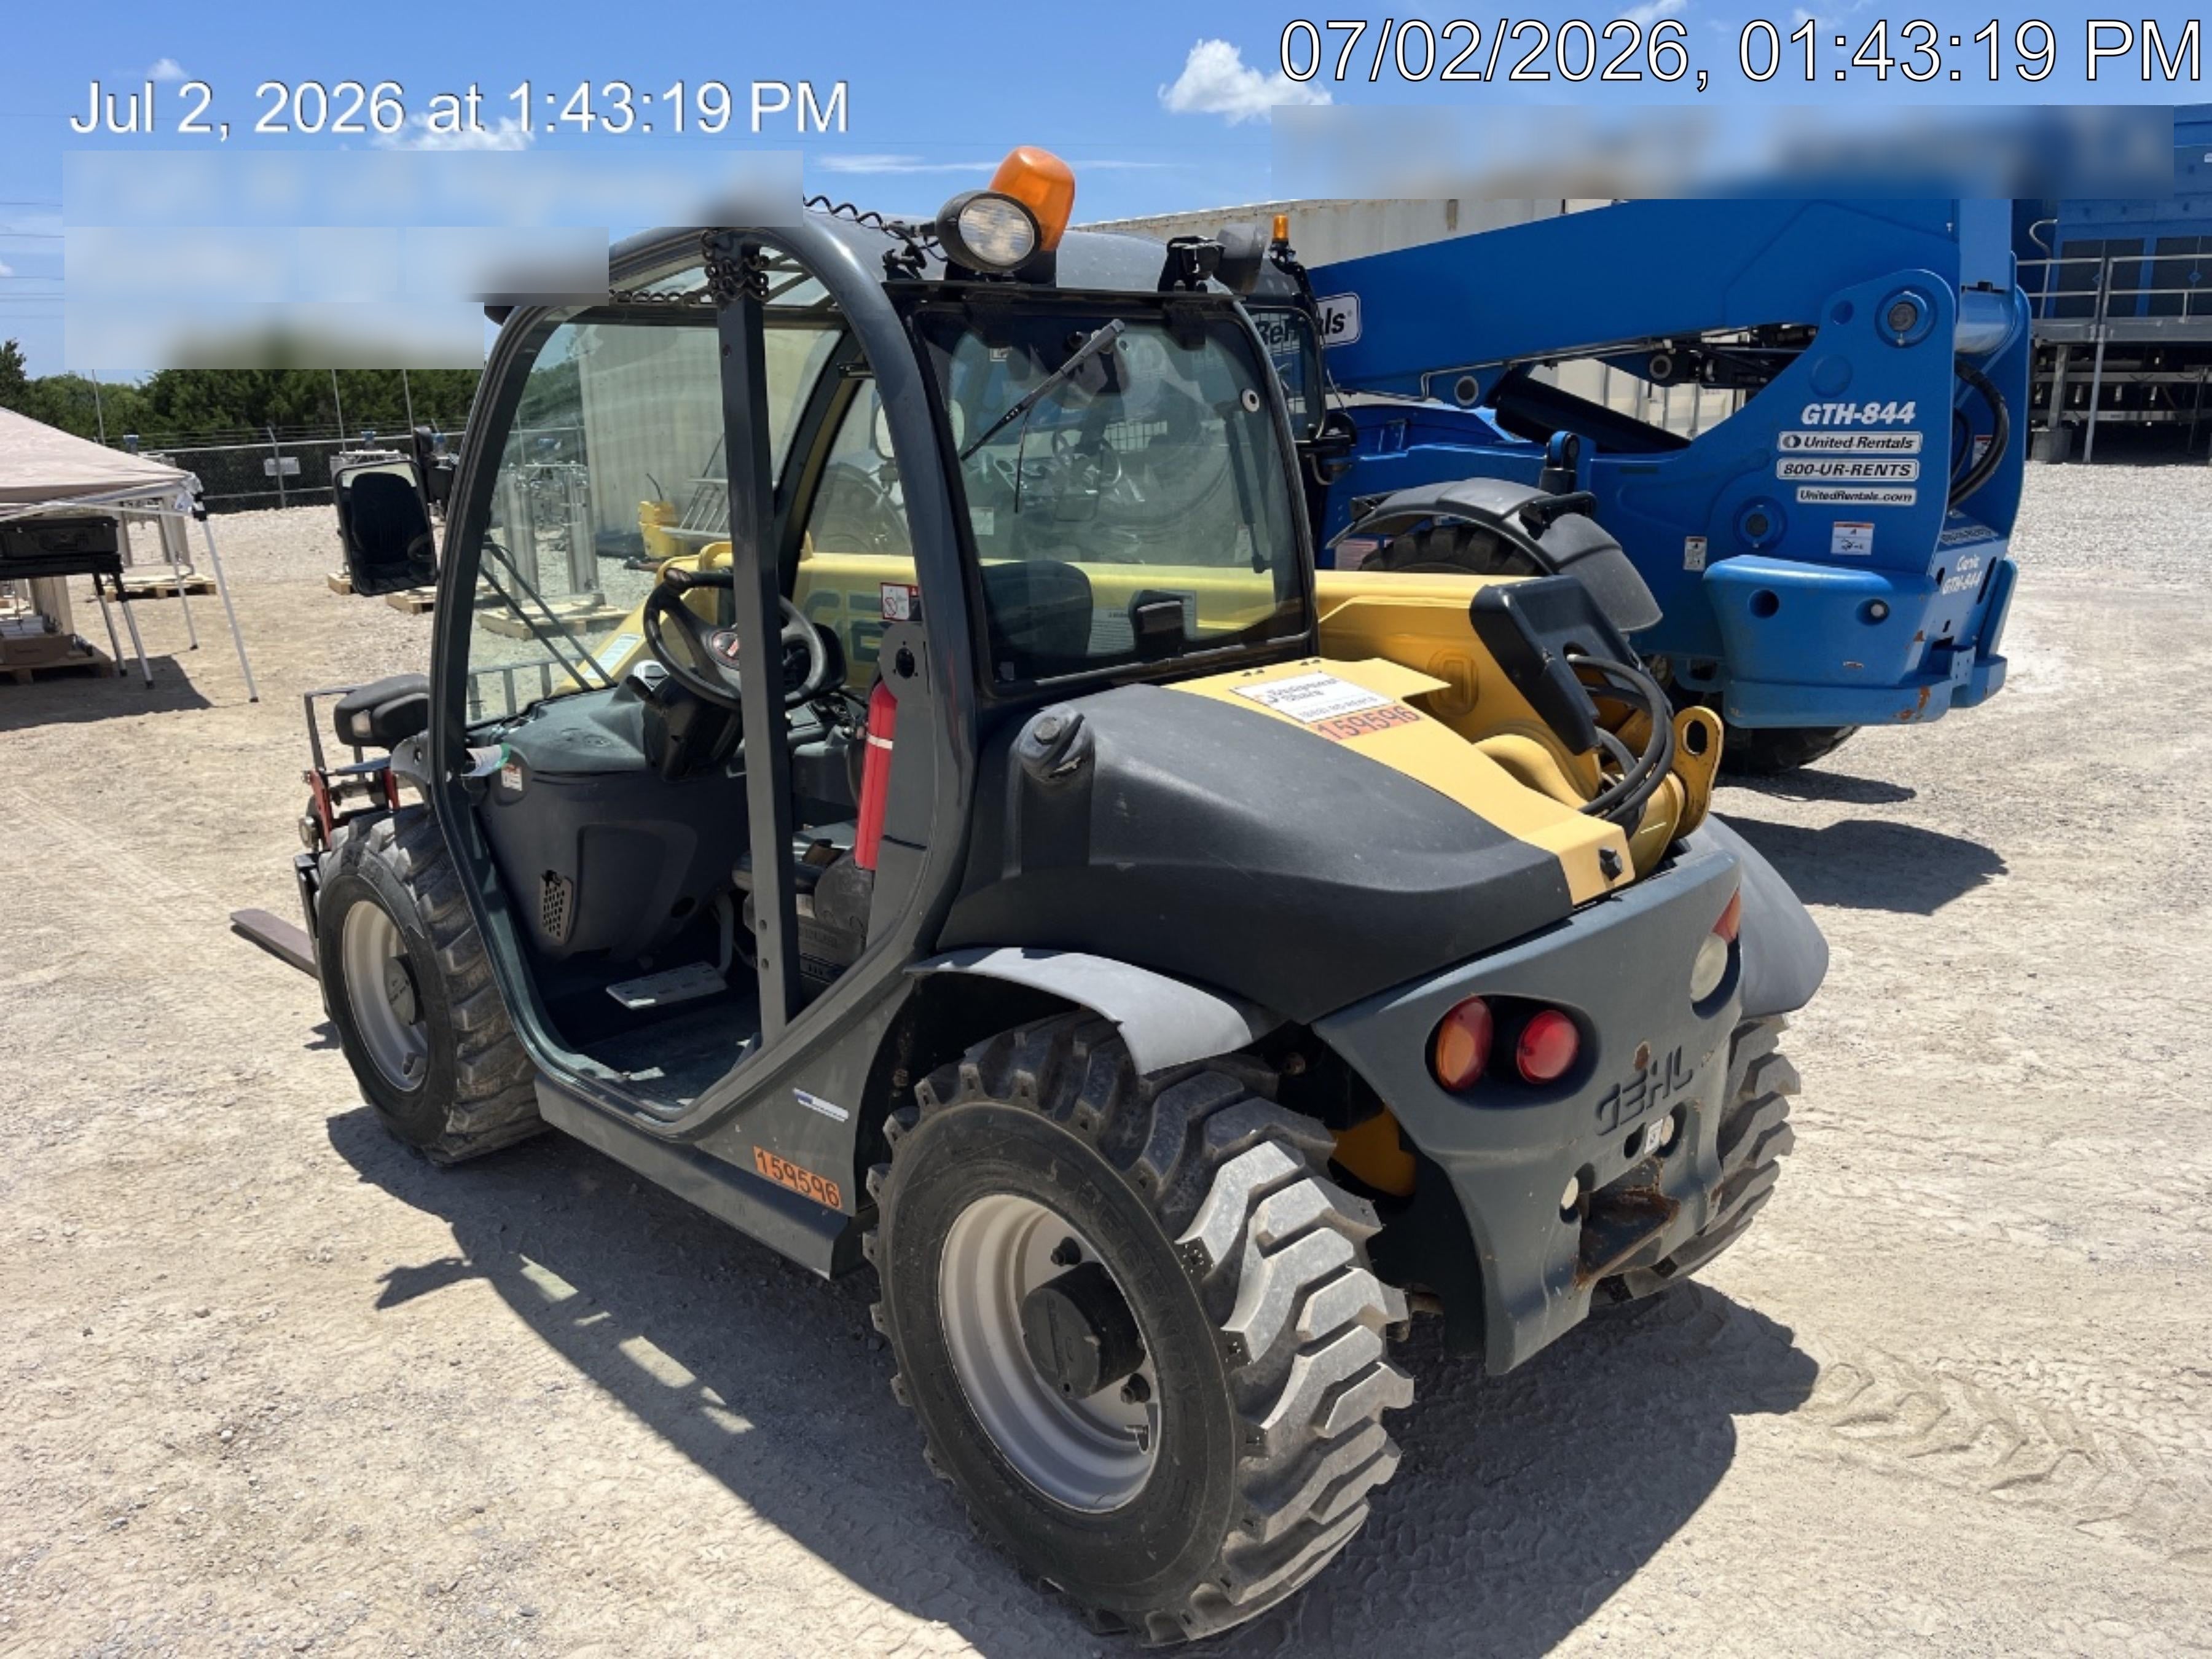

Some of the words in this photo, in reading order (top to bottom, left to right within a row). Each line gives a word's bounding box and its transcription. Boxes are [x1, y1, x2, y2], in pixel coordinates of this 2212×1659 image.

[1801, 401, 1916, 425] GTH-844
[1804, 436, 1854, 449] United
[1856, 436, 1913, 449] Rentals
[1784, 463, 1912, 476] 800-UR-RENTS
[1800, 490, 1913, 502] UnitedRentals.com
[1317, 705, 1421, 739] 159596
[1595, 1045, 1693, 1136] GEHL
[758, 1150, 840, 1206] 159596
